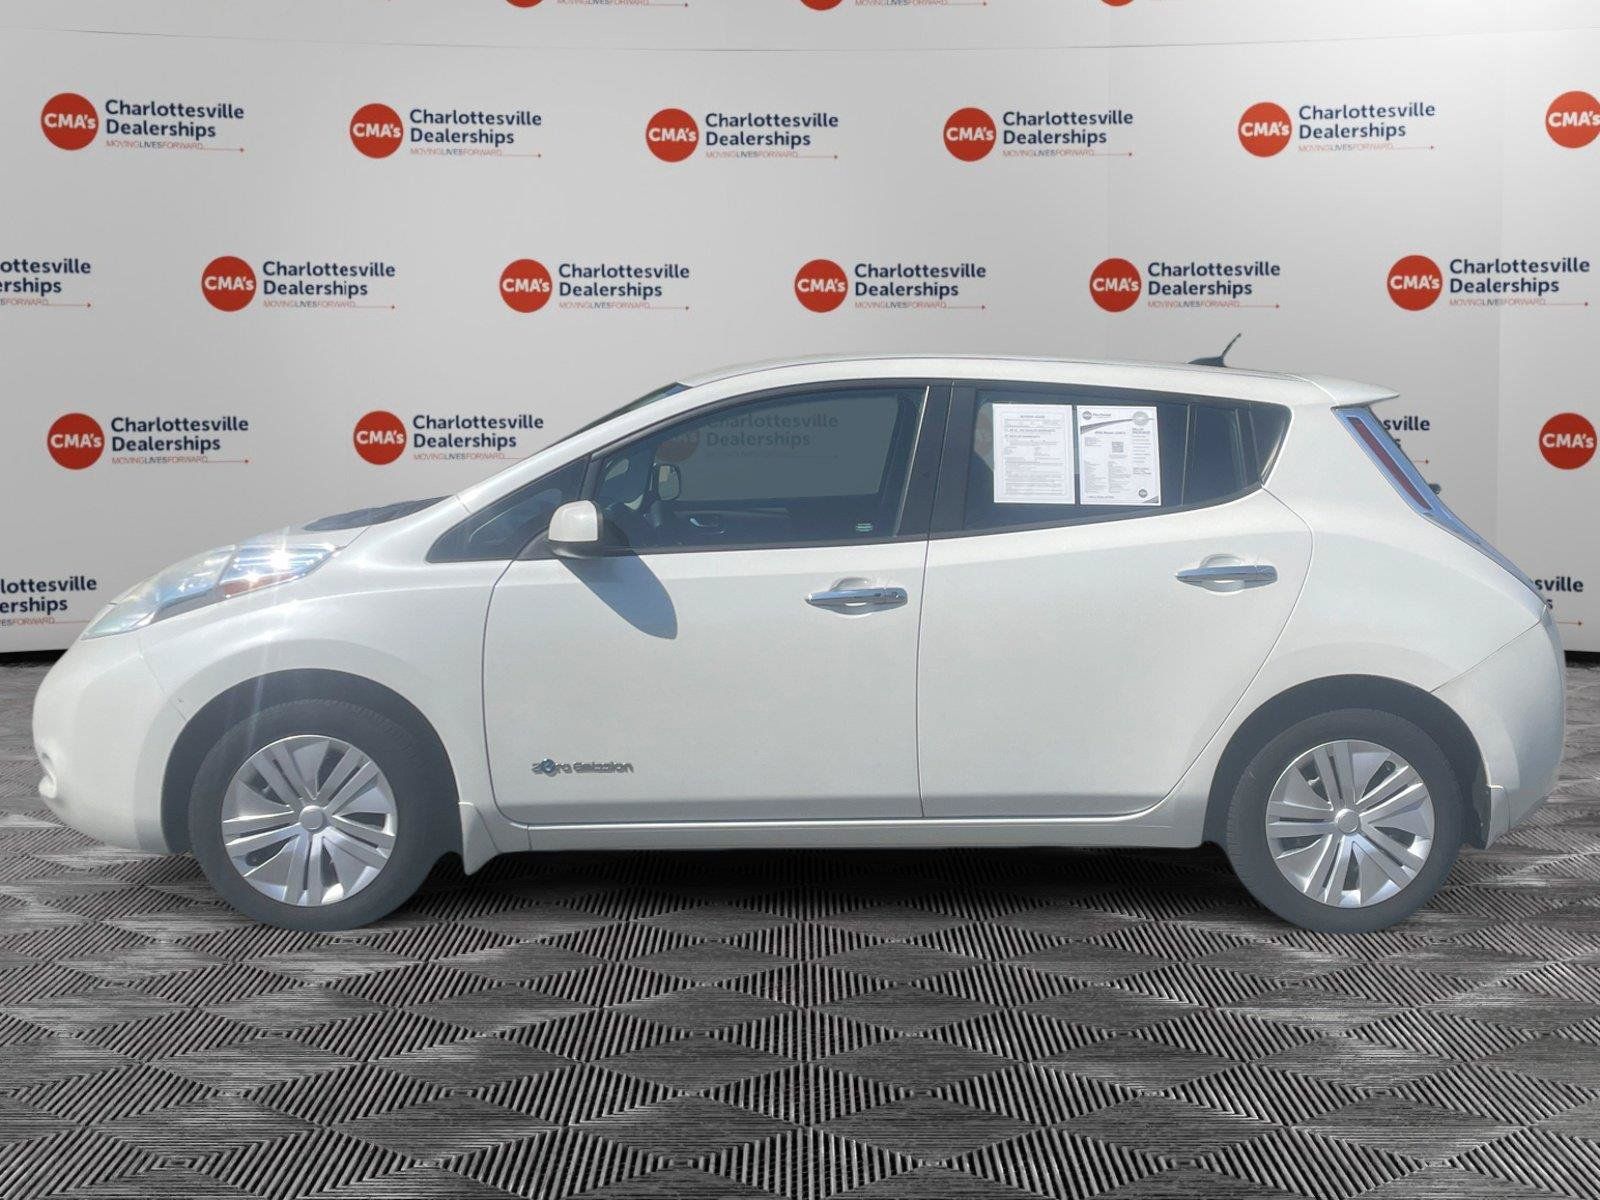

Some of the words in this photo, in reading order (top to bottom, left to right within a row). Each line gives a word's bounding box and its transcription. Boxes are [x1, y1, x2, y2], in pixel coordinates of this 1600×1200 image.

[105, 100, 245, 119] Charlottesville
[409, 109, 542, 126] Charlottesville
[1002, 110, 1134, 126] Charlottesville
[1299, 102, 1436, 120] Charlottesville
[44, 112, 96, 130] CMA's
[705, 113, 839, 128] Charlottesville
[1548, 110, 1600, 127] CMA's
[106, 119, 217, 139] Dealerships
[352, 122, 401, 138] CMA's
[410, 127, 515, 146] Dealerships
[648, 127, 697, 142] CMA's
[946, 126, 994, 141] CMA's
[1003, 128, 1107, 147] Dealerships
[1240, 121, 1290, 137] CMA's
[1299, 121, 1406, 140] Dealerships
[706, 131, 811, 149] Dealerships
[0, 258, 91, 274] ottesville
[262, 261, 396, 278] Charlottesville
[558, 263, 690, 279] Charlottesville
[854, 263, 987, 278] Charlottesville
[1148, 261, 1281, 277] Charlottesville
[1449, 257, 1590, 275] Charlottesville
[204, 276, 254, 291] CMA's
[263, 280, 368, 298] Dealerships
[502, 278, 550, 293] CMA's
[559, 282, 663, 299] Dealerships
[797, 278, 846, 293] CMA's
[855, 282, 959, 299] Dealerships
[1092, 277, 1139, 292] CMA's
[1148, 280, 1252, 298] Dealerships
[1390, 275, 1441, 291] CMA's
[1450, 277, 1560, 296] Dealerships
[110, 416, 249, 433] Charlottesville
[412, 414, 544, 430] Charlottesville
[50, 432, 102, 449] CMA's
[111, 435, 221, 454] Dealerships
[356, 428, 404, 444] CMA's
[413, 433, 517, 451] Dealerships
[706, 432, 811, 450] Dealerships
[1542, 433, 1594, 448] CMA's
[0, 576, 97, 594] lottesville
[0, 597, 68, 615] erships
